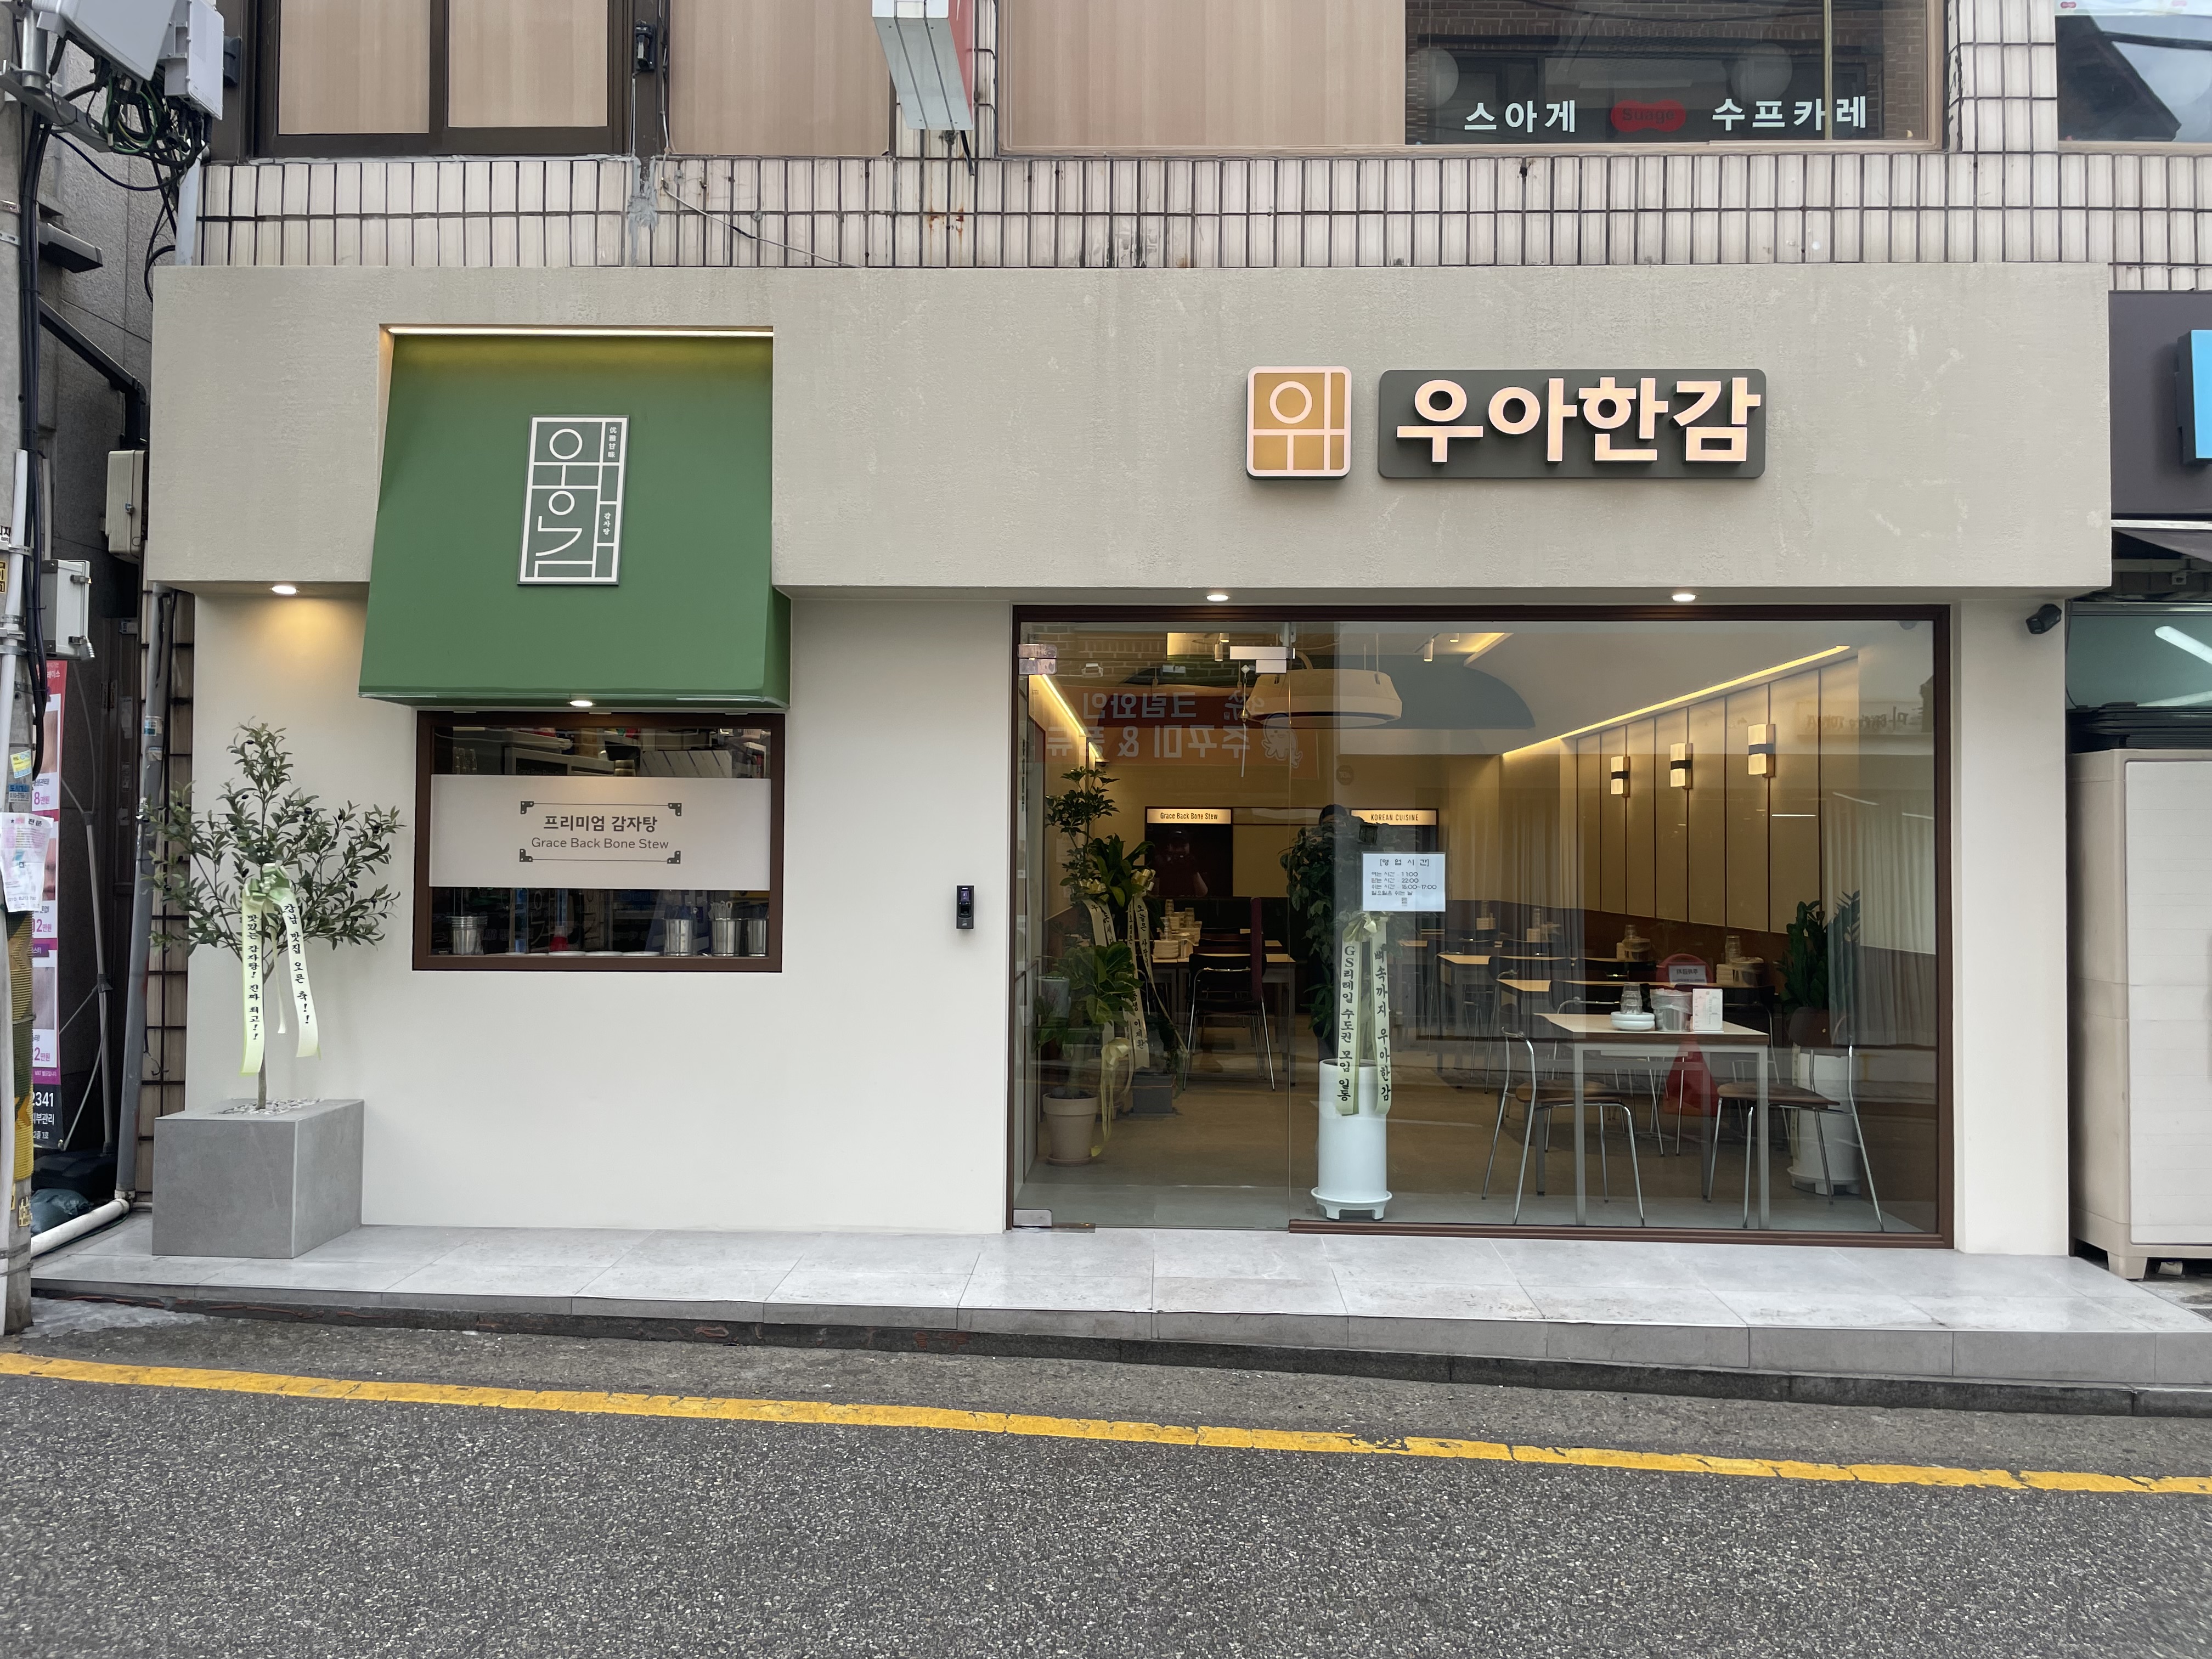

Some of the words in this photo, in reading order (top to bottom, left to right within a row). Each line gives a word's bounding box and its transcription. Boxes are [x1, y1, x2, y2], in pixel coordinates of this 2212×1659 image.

[1464, 100, 1576, 133] 스아게
[1622, 108, 1675, 124] Suage
[1711, 96, 1867, 131] 수프카레
[1397, 376, 1761, 463] 우아한감
[544, 815, 605, 832] 프리미엄
[611, 815, 658, 833] 감자탕
[531, 837, 567, 848] Grace
[571, 838, 601, 848] Back
[604, 838, 635, 849] Bone
[639, 838, 669, 849] Stew
[284, 904, 299, 925] 강남
[246, 914, 261, 940] 맛있는
[290, 931, 302, 955] 맛집
[294, 961, 306, 984] 오픈
[1342, 945, 1356, 1004] GS리테일
[247, 984, 261, 1001] 진짜
[1340, 1007, 1355, 1043] 수도권
[1338, 1049, 1353, 1073] 모임
[1377, 1027, 1391, 1102] 우아한감
[1337, 1077, 1351, 1102] 일동
